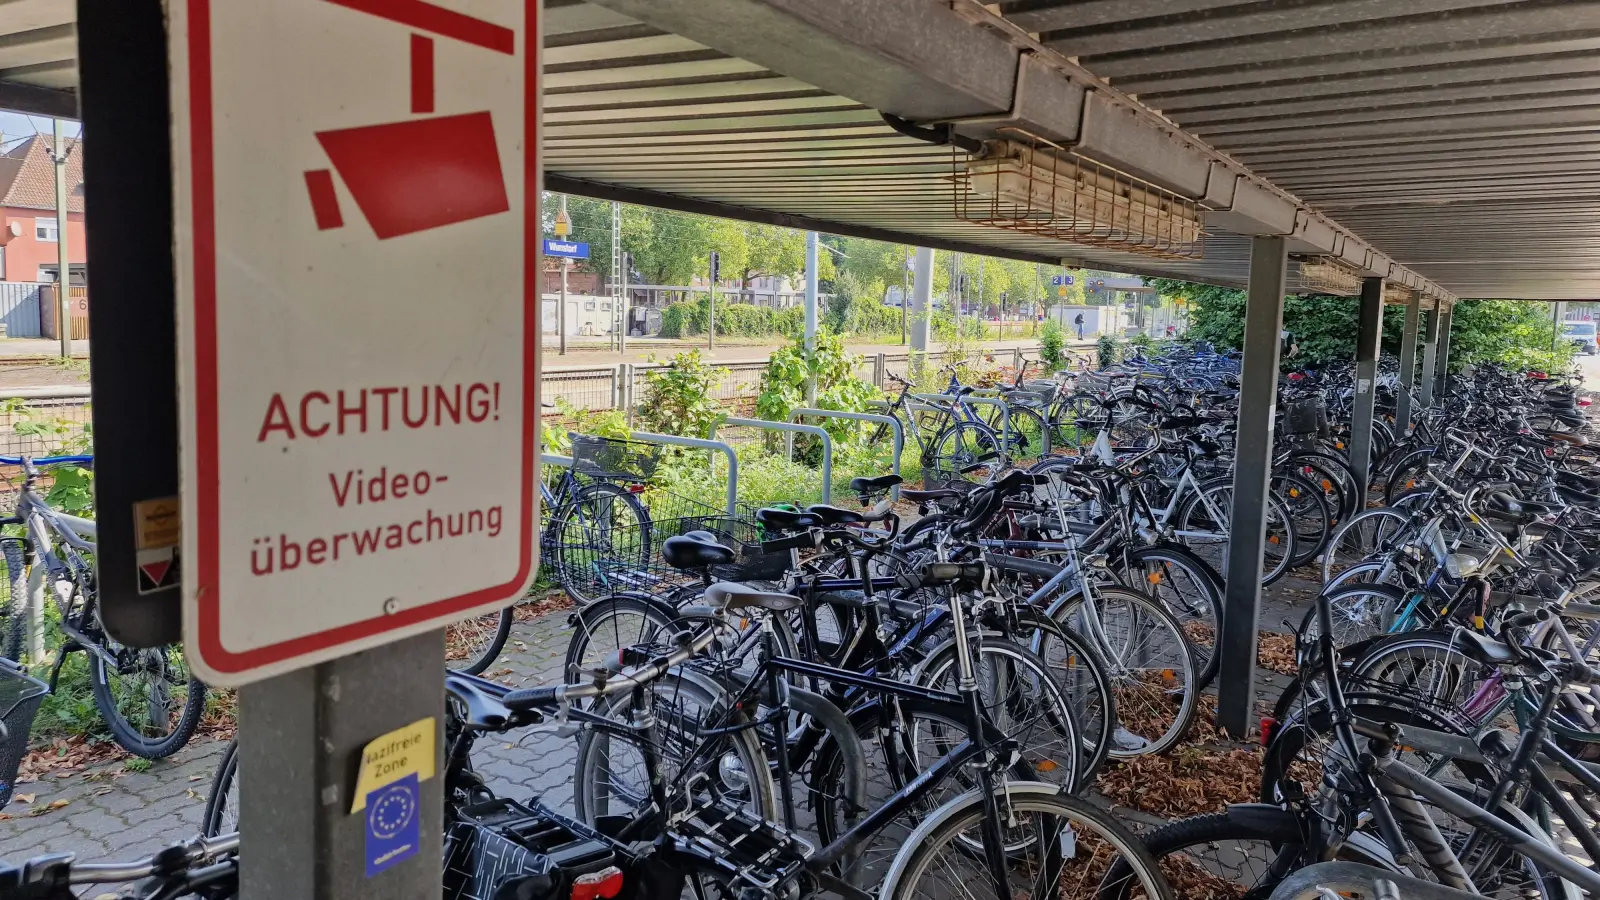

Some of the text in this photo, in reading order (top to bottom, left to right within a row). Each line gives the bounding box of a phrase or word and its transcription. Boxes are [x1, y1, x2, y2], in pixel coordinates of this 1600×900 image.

[549, 241, 577, 253] Wunstorf
[1053, 276, 1059, 284] 2
[1068, 276, 1073, 284] 3
[79, 299, 87, 310] 6
[257, 381, 500, 443] ACHTUNG!
[328, 465, 449, 508] Video-
[250, 504, 502, 577] überwachung
[375, 756, 408, 778] Zone
